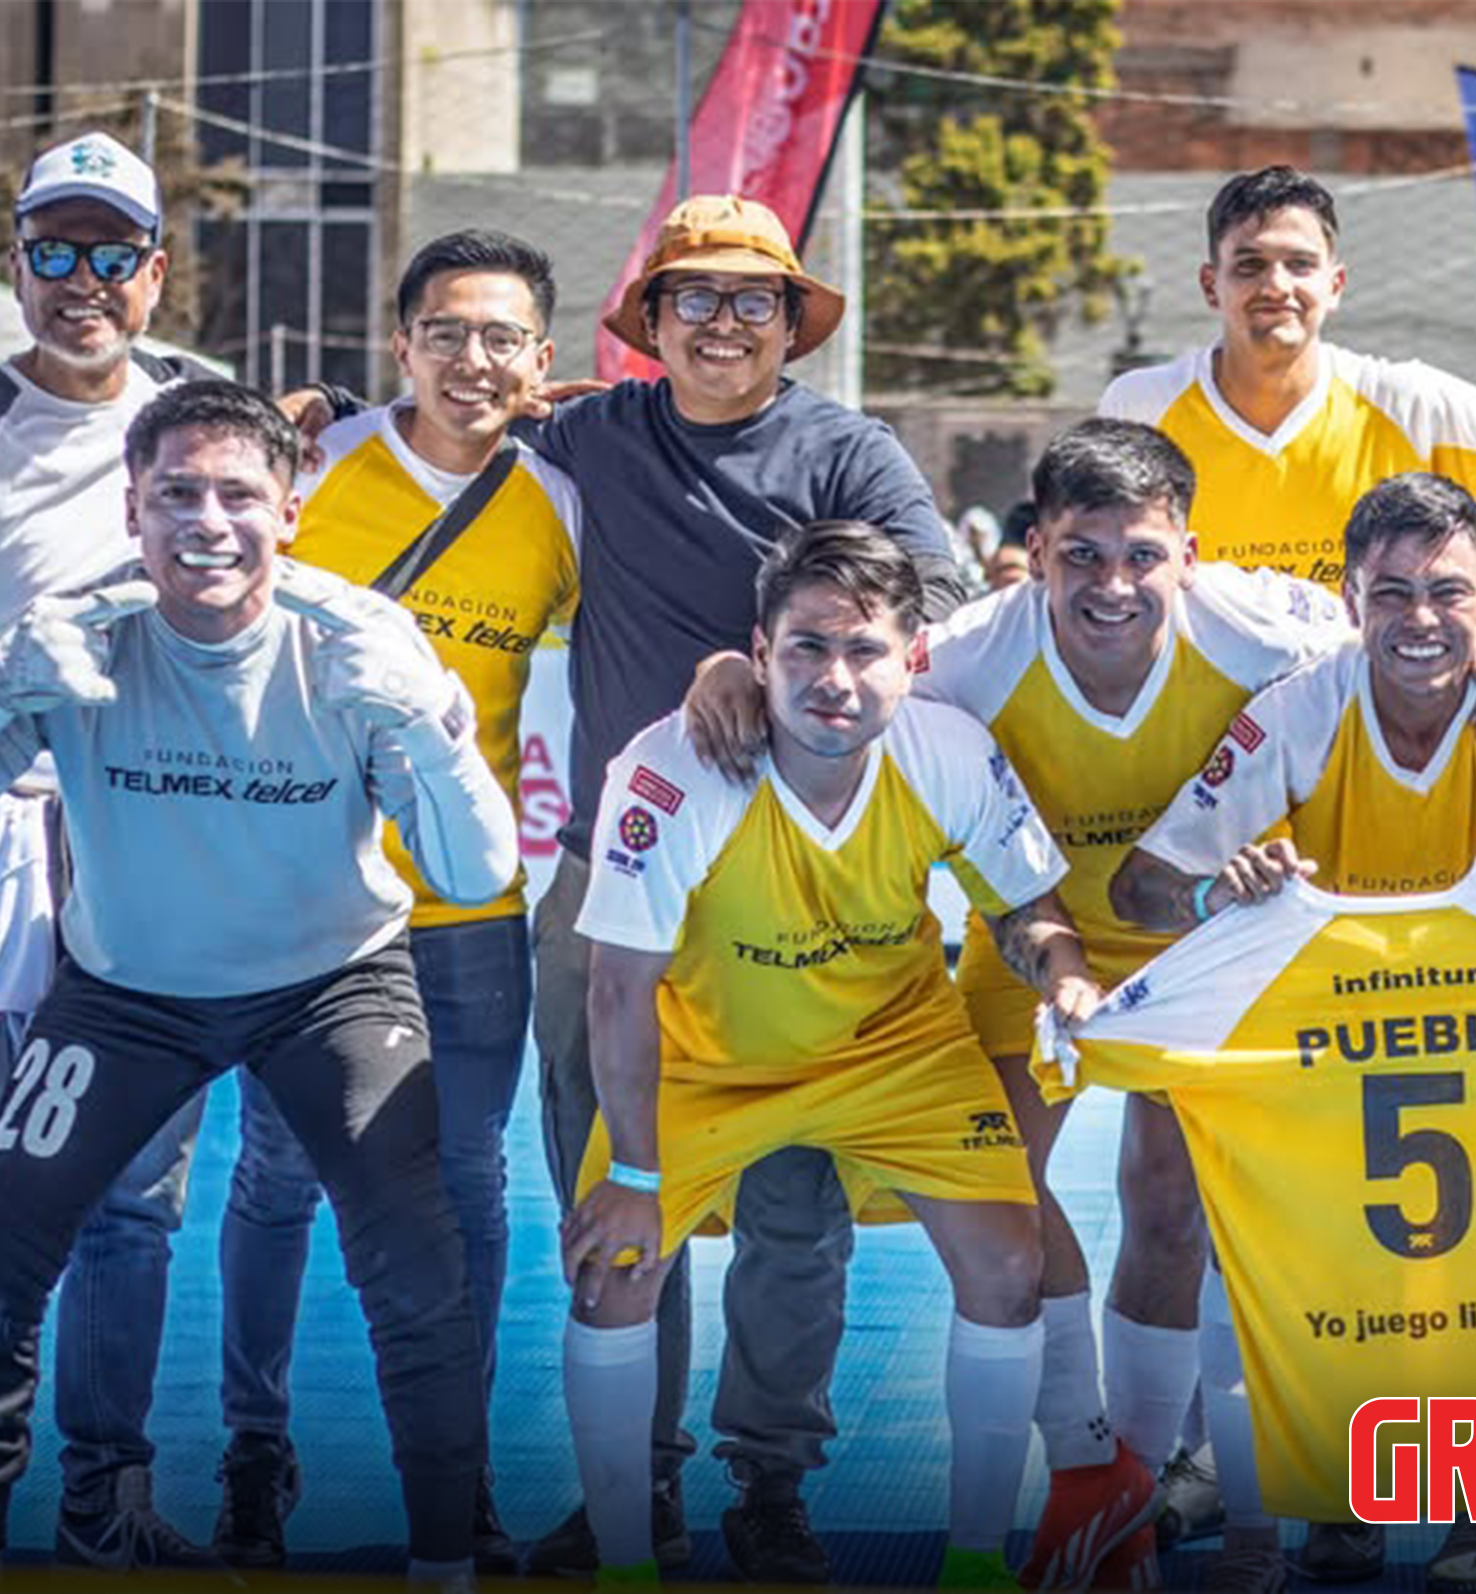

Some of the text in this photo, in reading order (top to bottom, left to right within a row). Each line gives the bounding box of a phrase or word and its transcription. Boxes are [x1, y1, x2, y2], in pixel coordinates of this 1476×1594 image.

[463, 620, 534, 654] telce
[105, 766, 339, 804] TELMEX telcel
[1347, 869, 1458, 892] FUNDACI
[0, 1038, 95, 1158] 28
[1362, 1071, 1473, 1260] 5
[1306, 1311, 1346, 1338] Yo
[1356, 1309, 1448, 1341] juego
